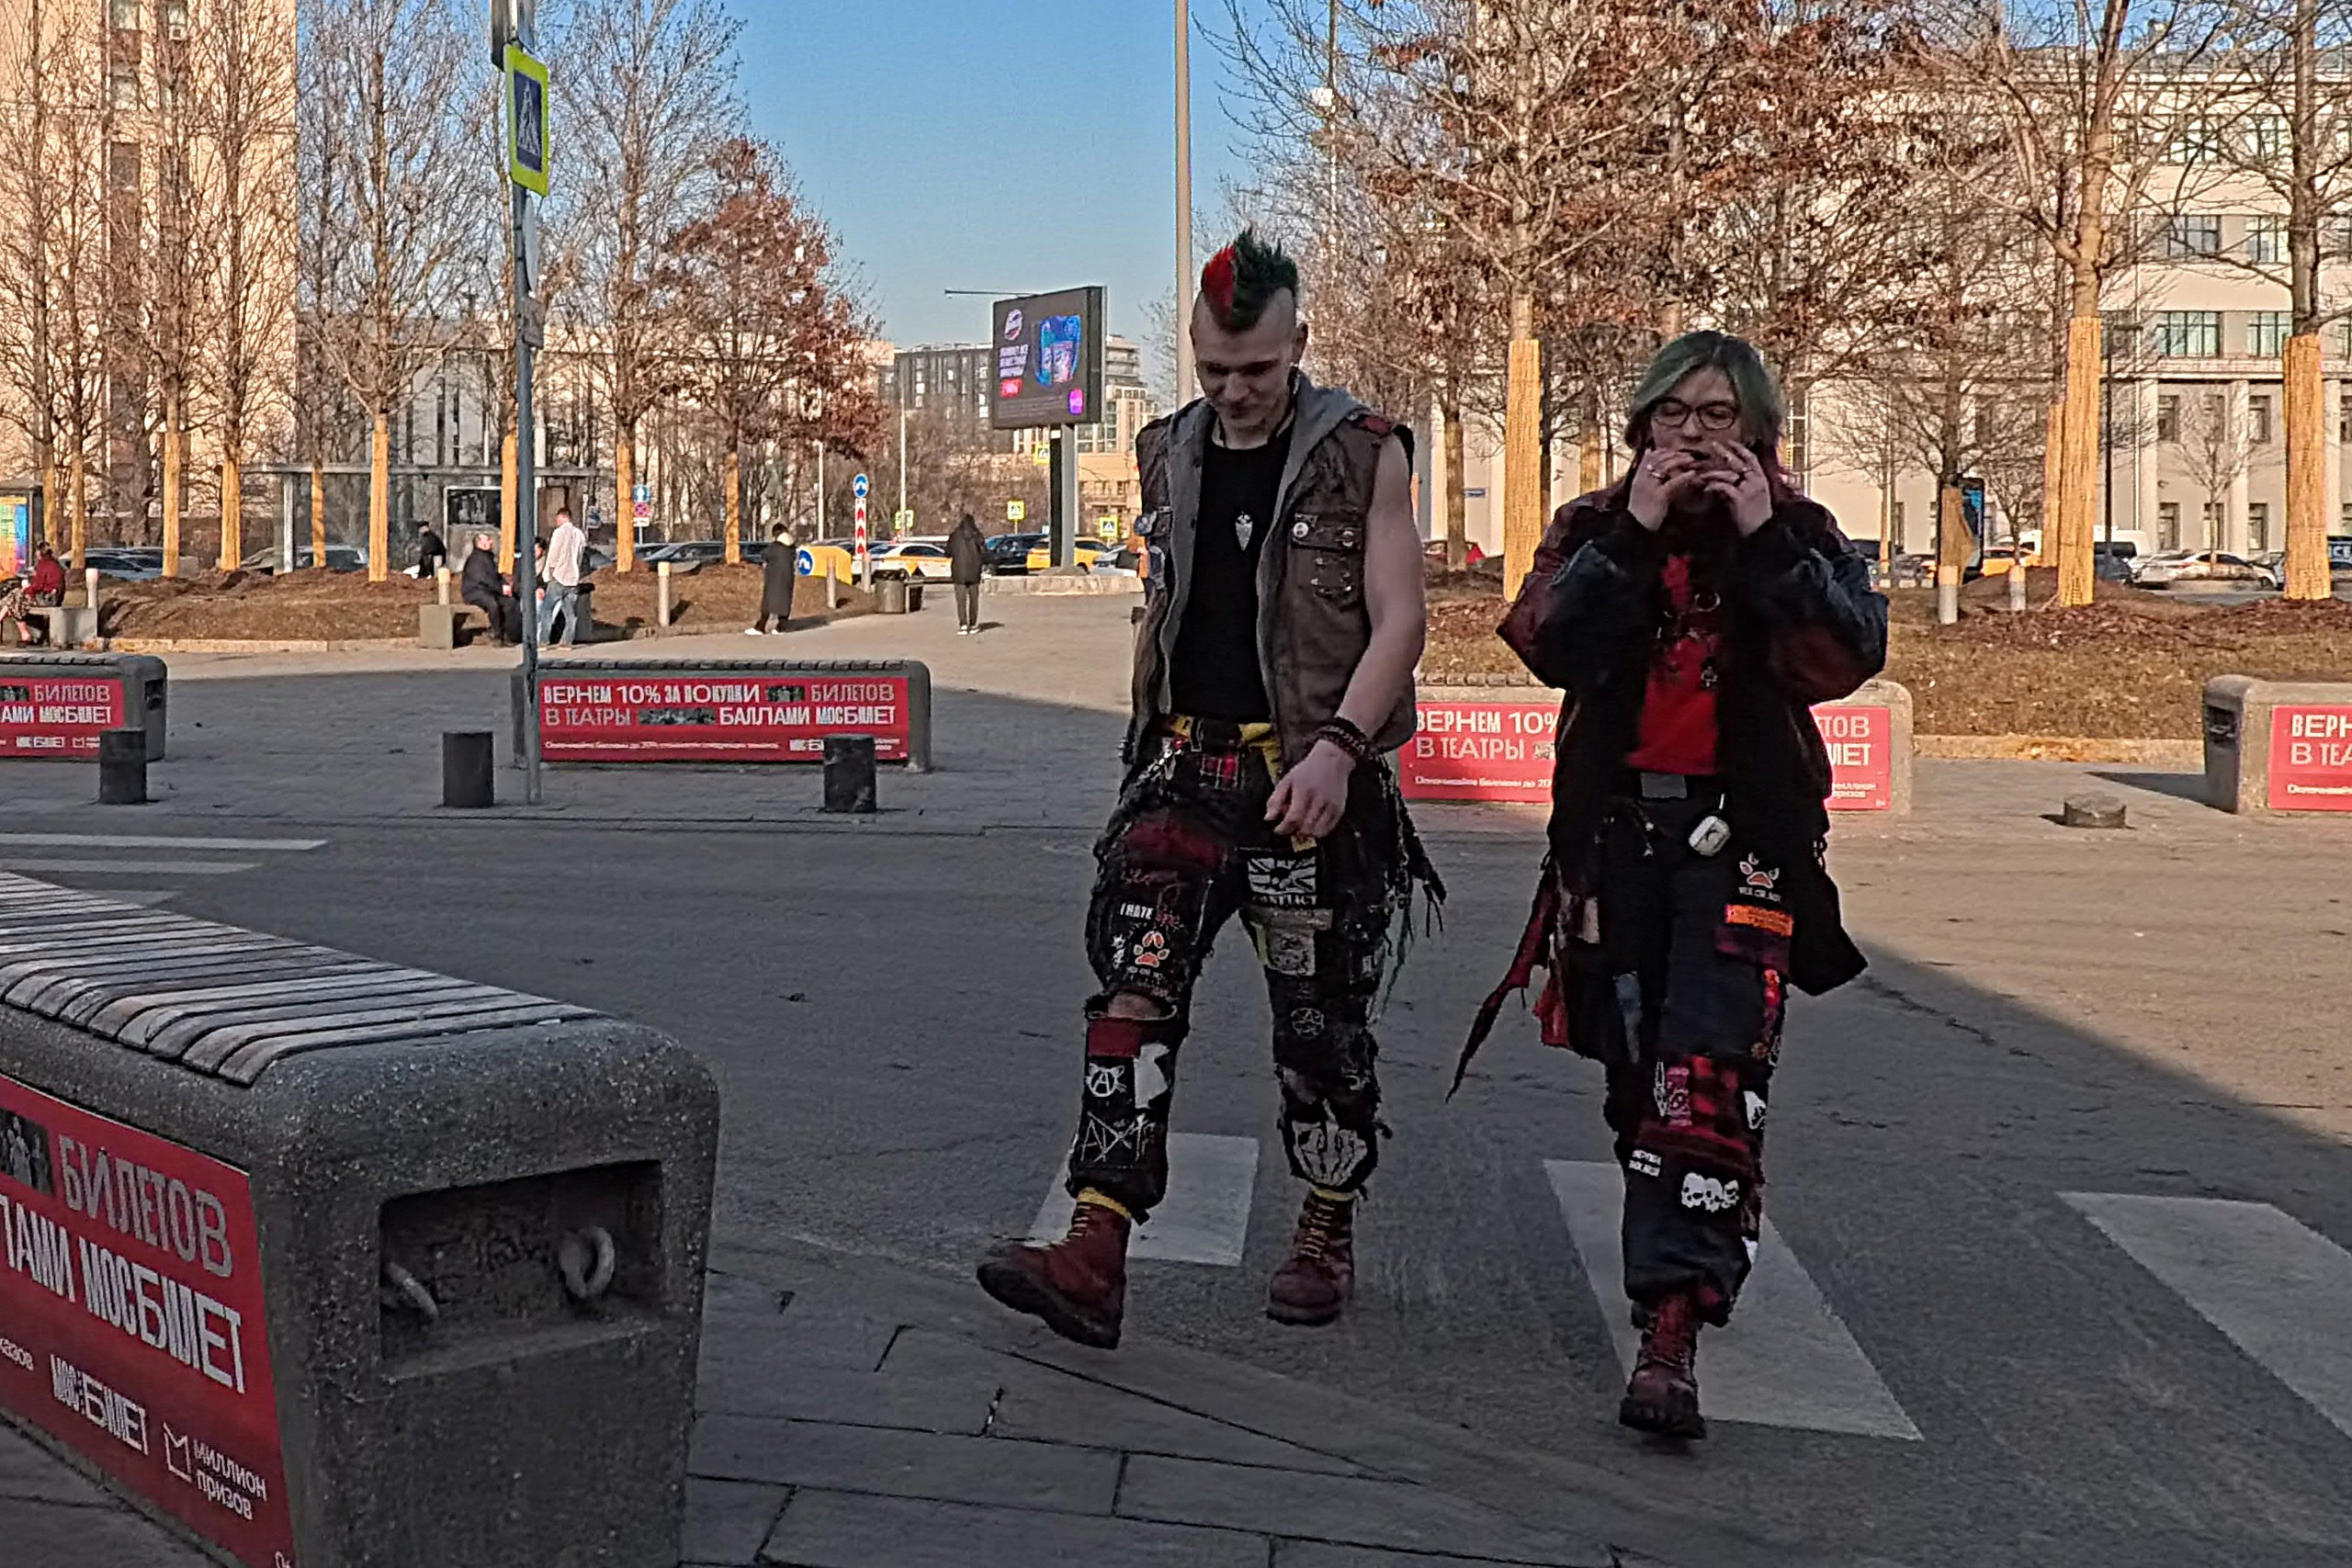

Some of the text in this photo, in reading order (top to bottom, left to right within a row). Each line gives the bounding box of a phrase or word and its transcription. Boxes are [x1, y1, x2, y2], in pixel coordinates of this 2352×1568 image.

[34, 684, 111, 703] БИЛЕТОВ
[544, 683, 895, 704] ВЕРНЕМ 10% ЗА ПОКУПКИ БИЛЕТОВ
[545, 708, 560, 726] В
[565, 707, 631, 727] ТЕАТРЫ
[719, 706, 810, 726] БАЛЛАМИ
[1416, 710, 1501, 733] ВЕРНЕМ
[1416, 737, 1525, 761] В ТЕАТРЫ
[2290, 742, 2313, 765] В
[58, 1134, 232, 1278] БИЛЕТОВ
